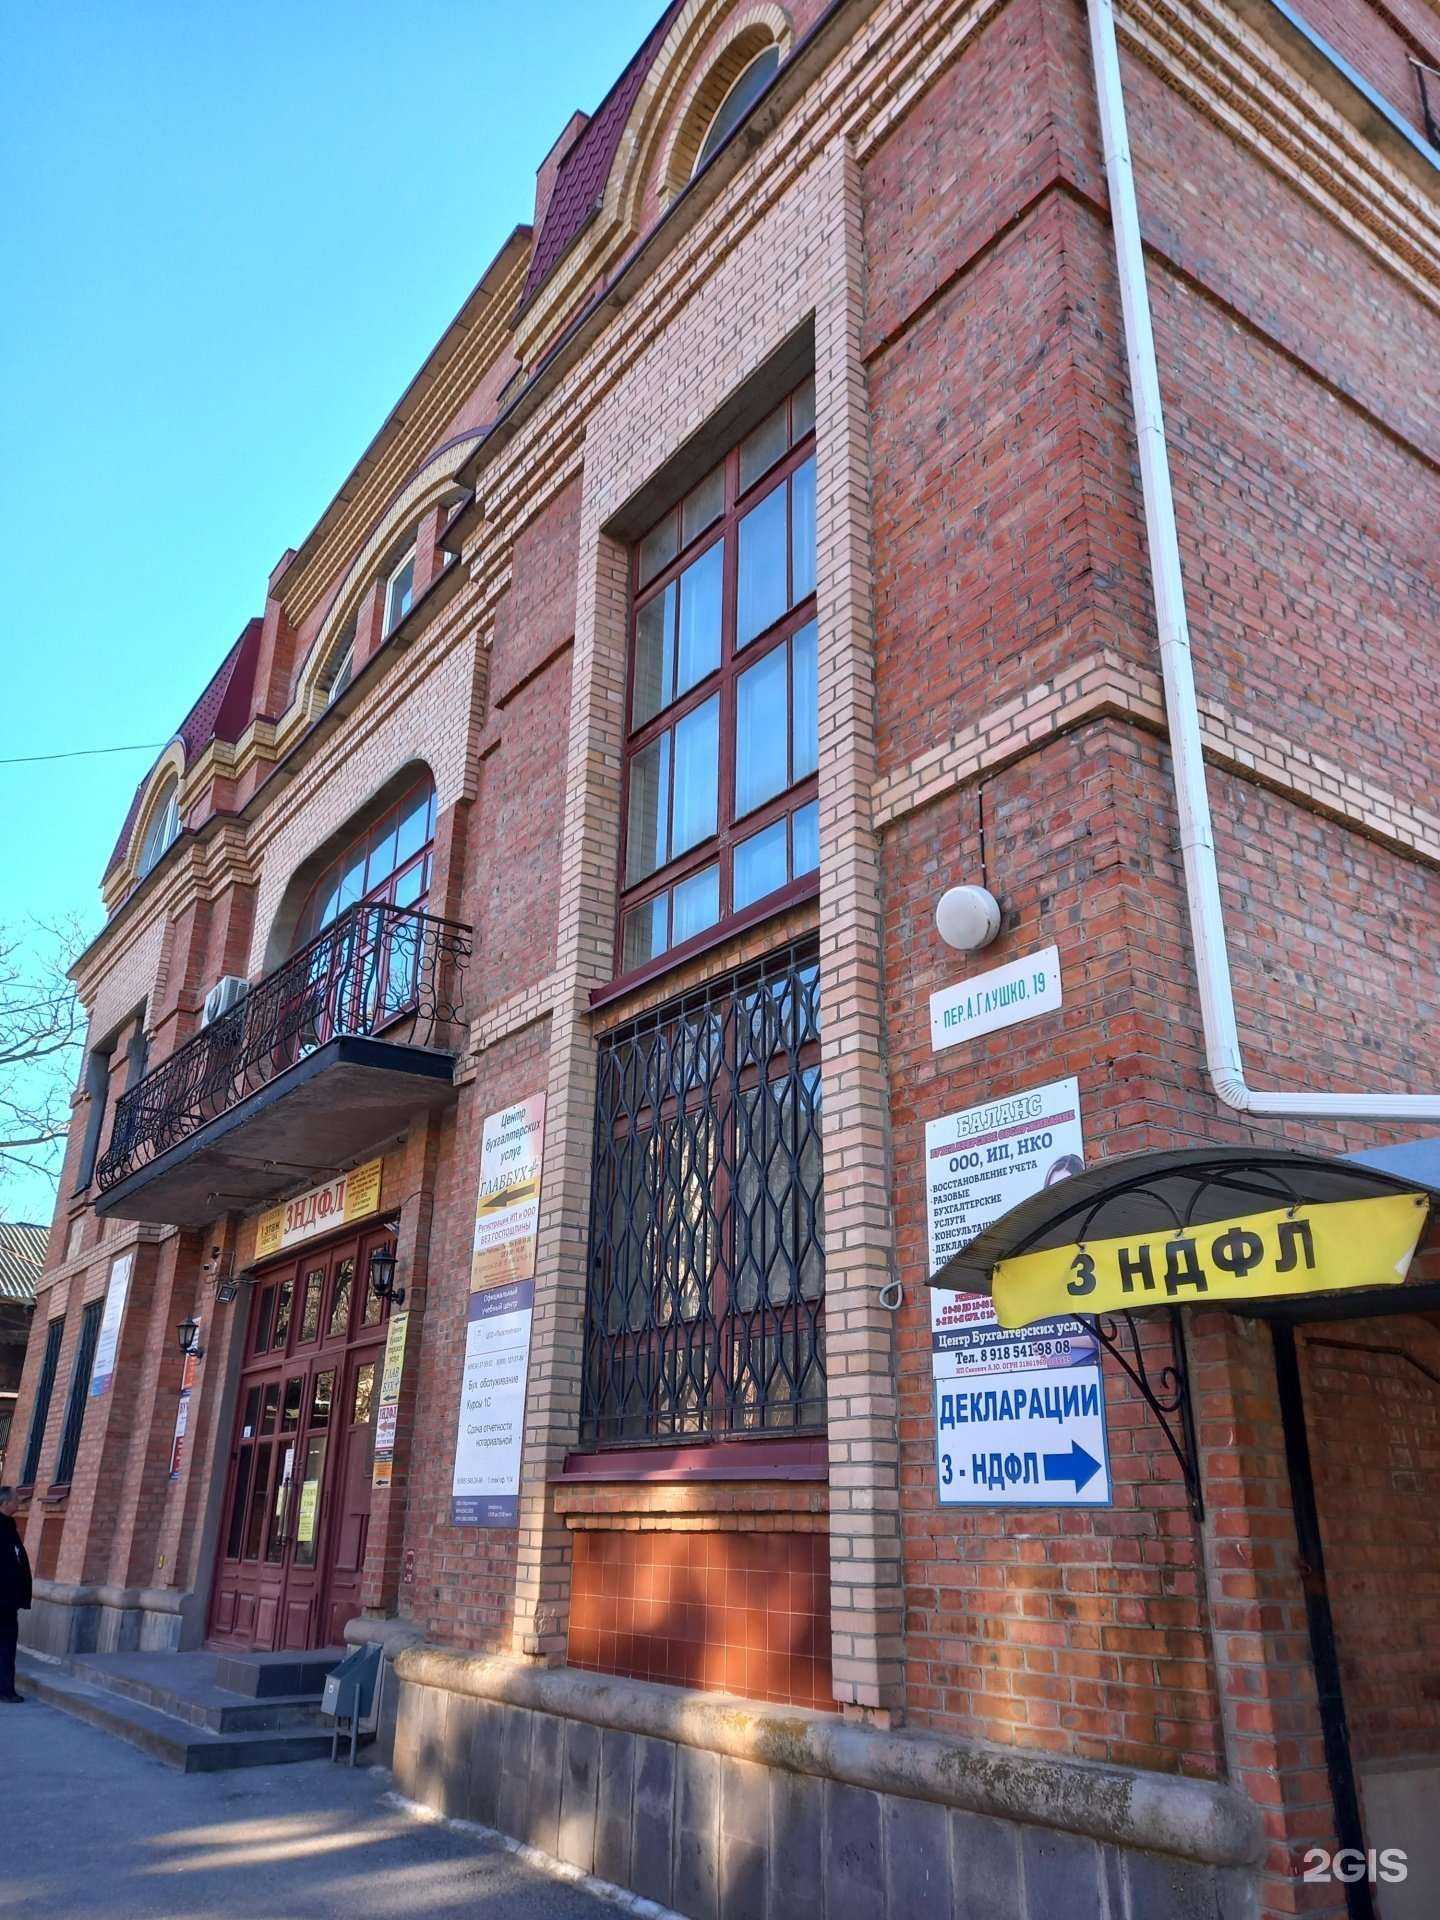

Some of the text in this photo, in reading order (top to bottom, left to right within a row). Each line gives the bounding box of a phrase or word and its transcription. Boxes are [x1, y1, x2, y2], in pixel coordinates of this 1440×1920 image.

[1033, 972, 1046, 995] 19
[501, 1108, 526, 1128] Центр
[957, 1094, 1042, 1137] БАЛАНС
[485, 1120, 541, 1152] бухгалтерских
[500, 1145, 521, 1165] услуг
[949, 1132, 1053, 1173] ООО, ИП, НКО
[933, 1160, 1038, 1193] ВОССТАНОВЛЕНИЕ УЧЕТА
[933, 1189, 970, 1205] РАЗОВЫЕ
[933, 1194, 1002, 1217] БУХГАЛТЕРСКИЕ
[934, 1214, 966, 1229] УСЛУГИ
[1066, 1219, 1316, 1297] 3 НДФЛ
[939, 1334, 970, 1348] Центр
[971, 1323, 1055, 1346] Бухгалтерских
[955, 1351, 978, 1365] Тел.
[980, 1349, 987, 1361] 8
[989, 1346, 1010, 1360] 918
[1055, 1340, 1071, 1354] 08
[467, 1400, 482, 1411] Курсы
[940, 1384, 1098, 1430] ДЕКЛАРАЦИИ
[972, 1452, 1040, 1491] НДФЛ
